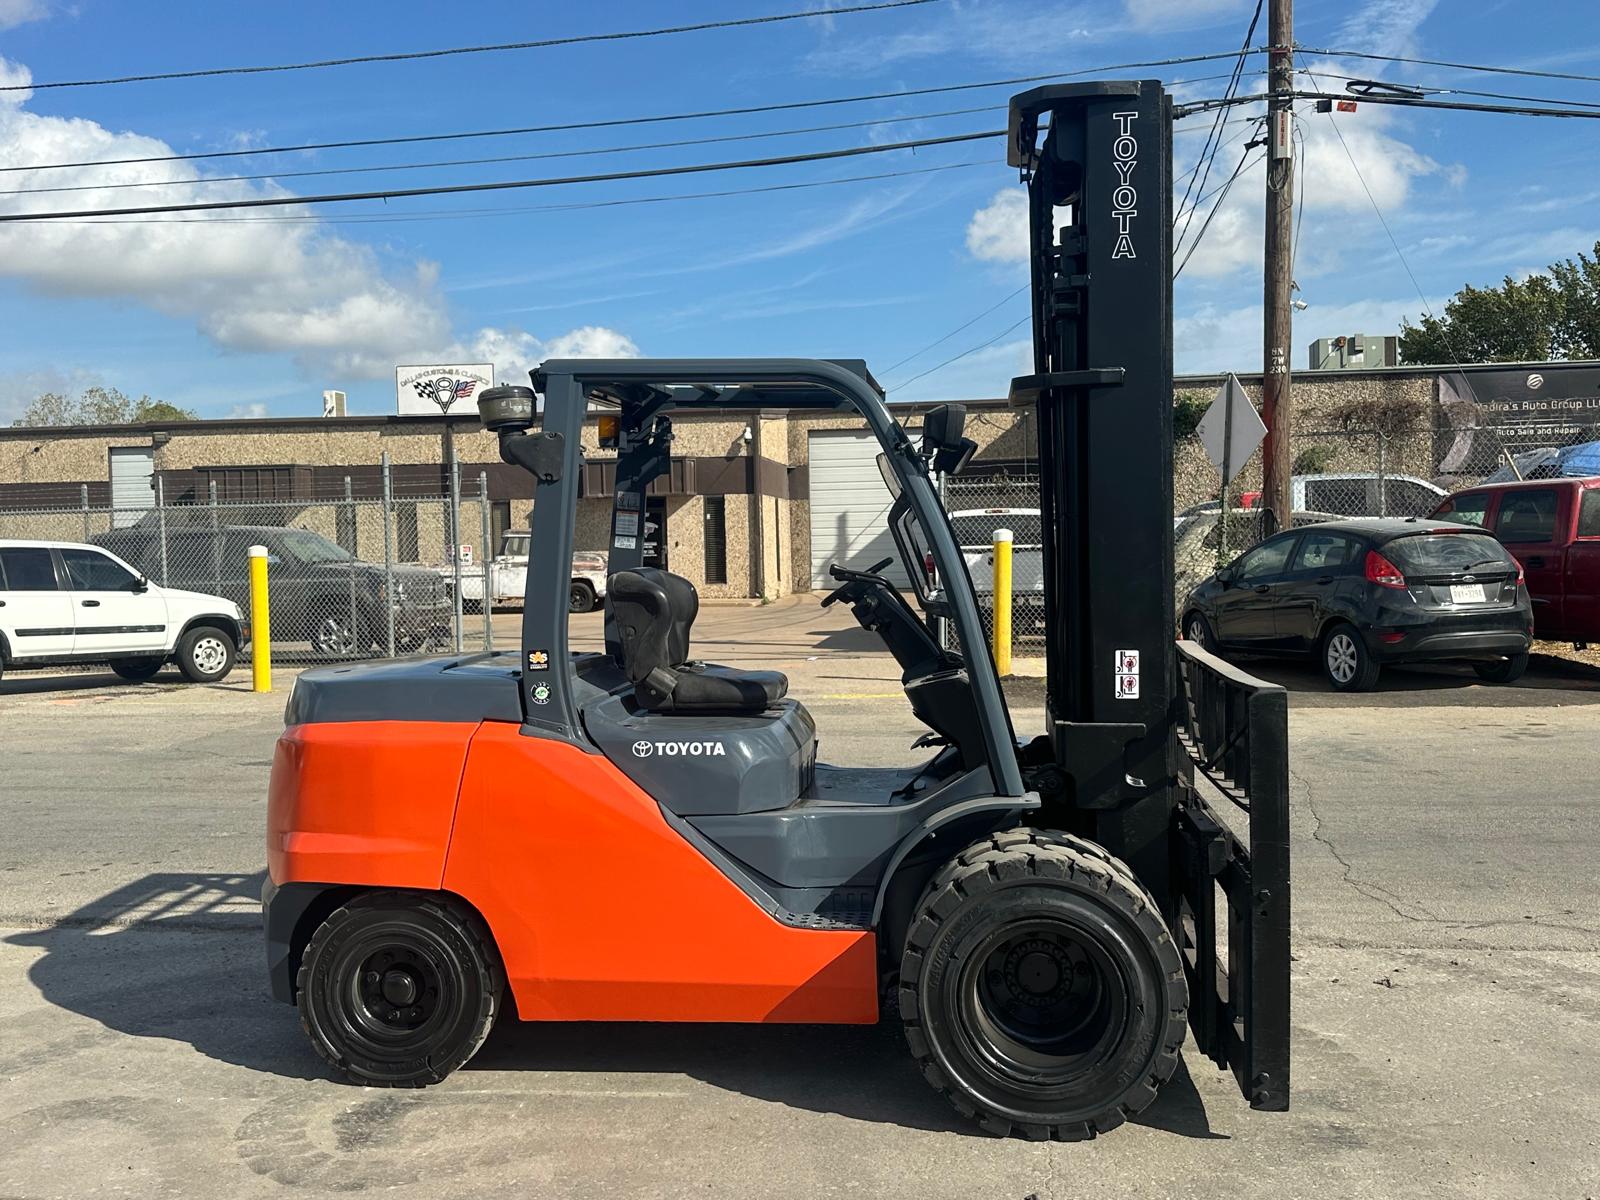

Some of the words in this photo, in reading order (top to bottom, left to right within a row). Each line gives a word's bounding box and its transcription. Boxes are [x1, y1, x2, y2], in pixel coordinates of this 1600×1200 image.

[1111, 111, 1139, 259] TOYOTA
[1270, 365, 1287, 374] 230
[1522, 401, 1547, 410] Auto
[1551, 400, 1583, 410] Group
[1586, 399, 1600, 408] LL
[654, 741, 726, 756] TOYOTA
